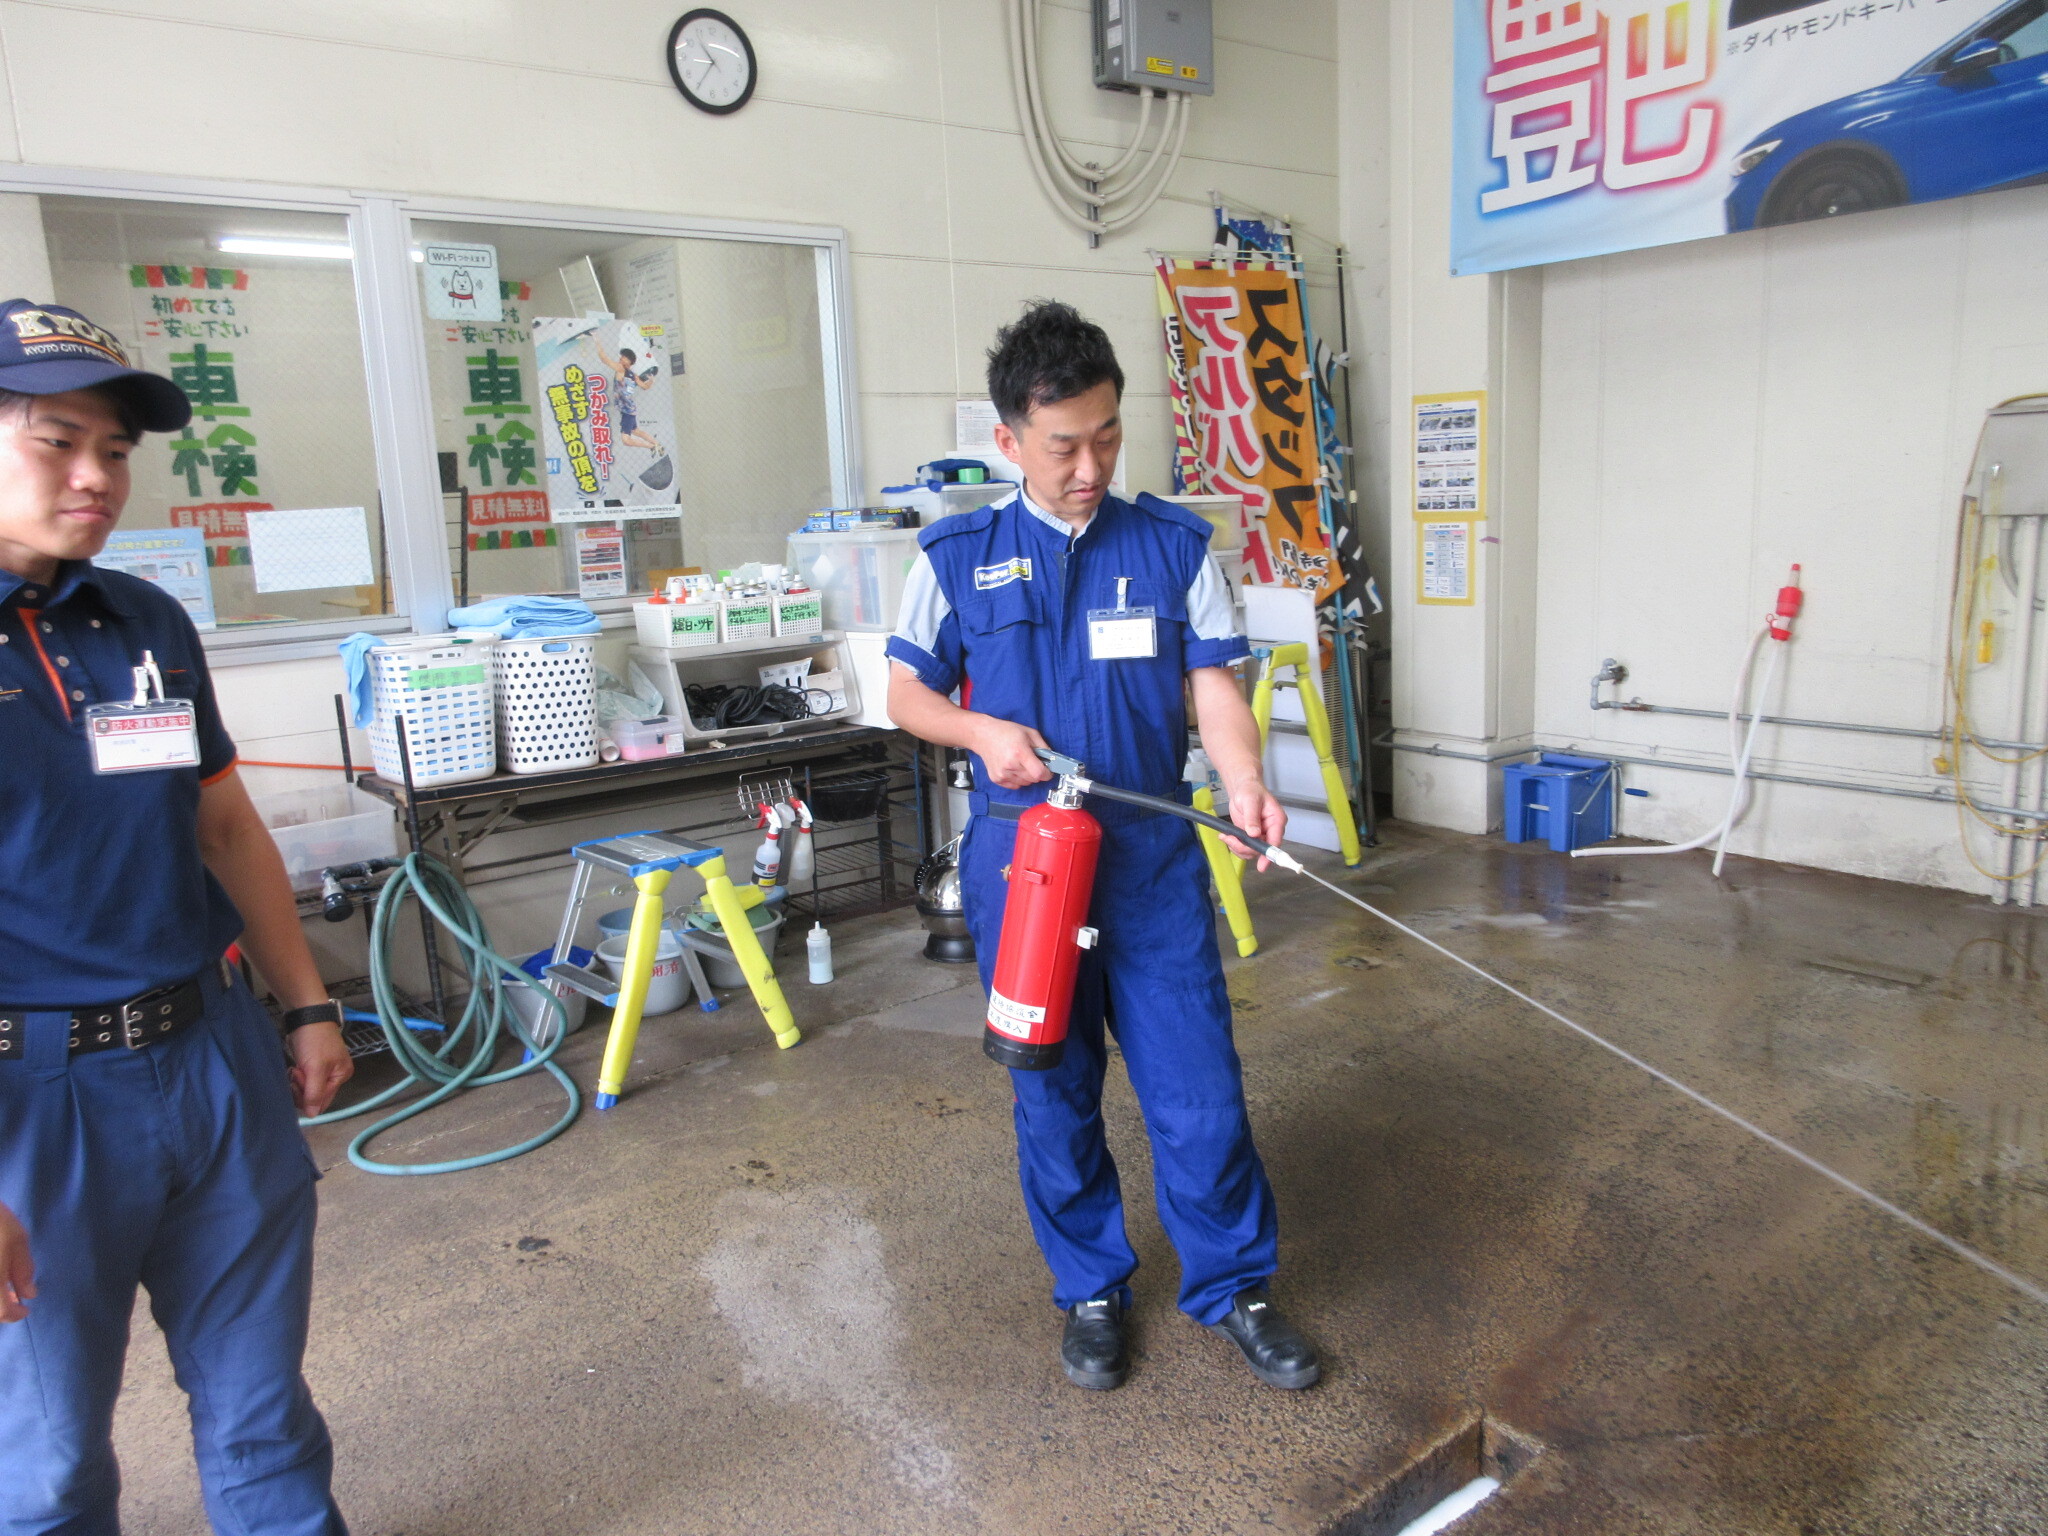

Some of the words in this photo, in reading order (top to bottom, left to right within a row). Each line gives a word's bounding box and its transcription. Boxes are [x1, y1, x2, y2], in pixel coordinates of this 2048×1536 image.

[151, 295, 235, 315] 初めてでも
[144, 318, 249, 338] ご安心下さい
[446, 325, 530, 343] ご安心下さい
[24, 344, 58, 356] KYOTO
[564, 364, 589, 420] めざす
[463, 348, 537, 486] 車検
[549, 385, 598, 493] 無事故の頂を
[472, 497, 549, 520] 見積無料
[177, 509, 247, 534] 見積無
